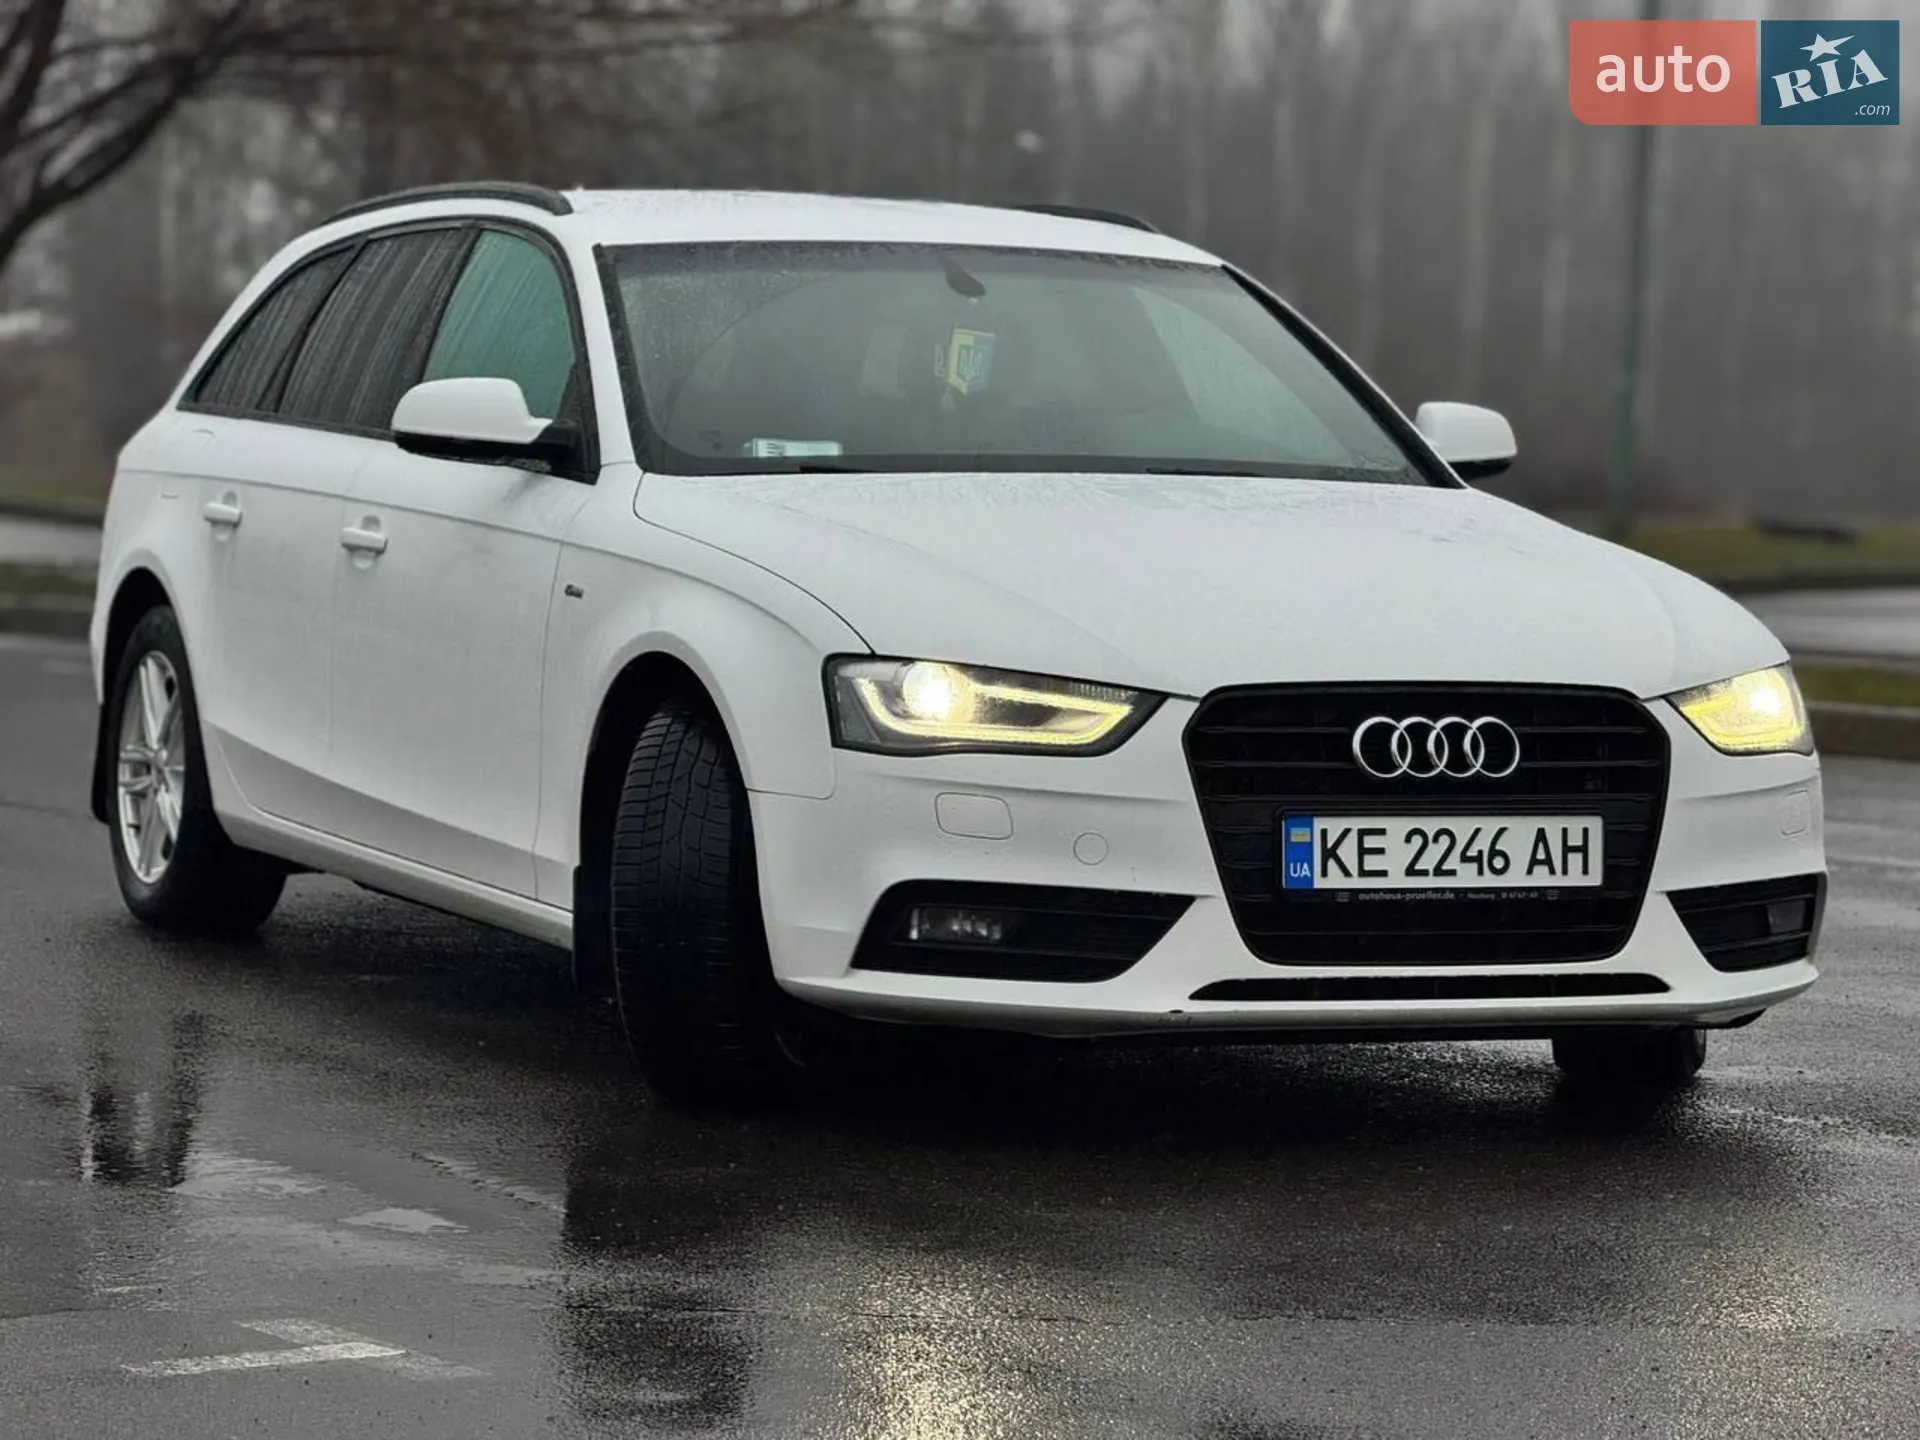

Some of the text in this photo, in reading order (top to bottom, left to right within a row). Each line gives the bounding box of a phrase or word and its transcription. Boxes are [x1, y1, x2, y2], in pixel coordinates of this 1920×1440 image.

[1319, 826, 1590, 878] KE 2246 AH
[1289, 862, 1311, 878] UA
